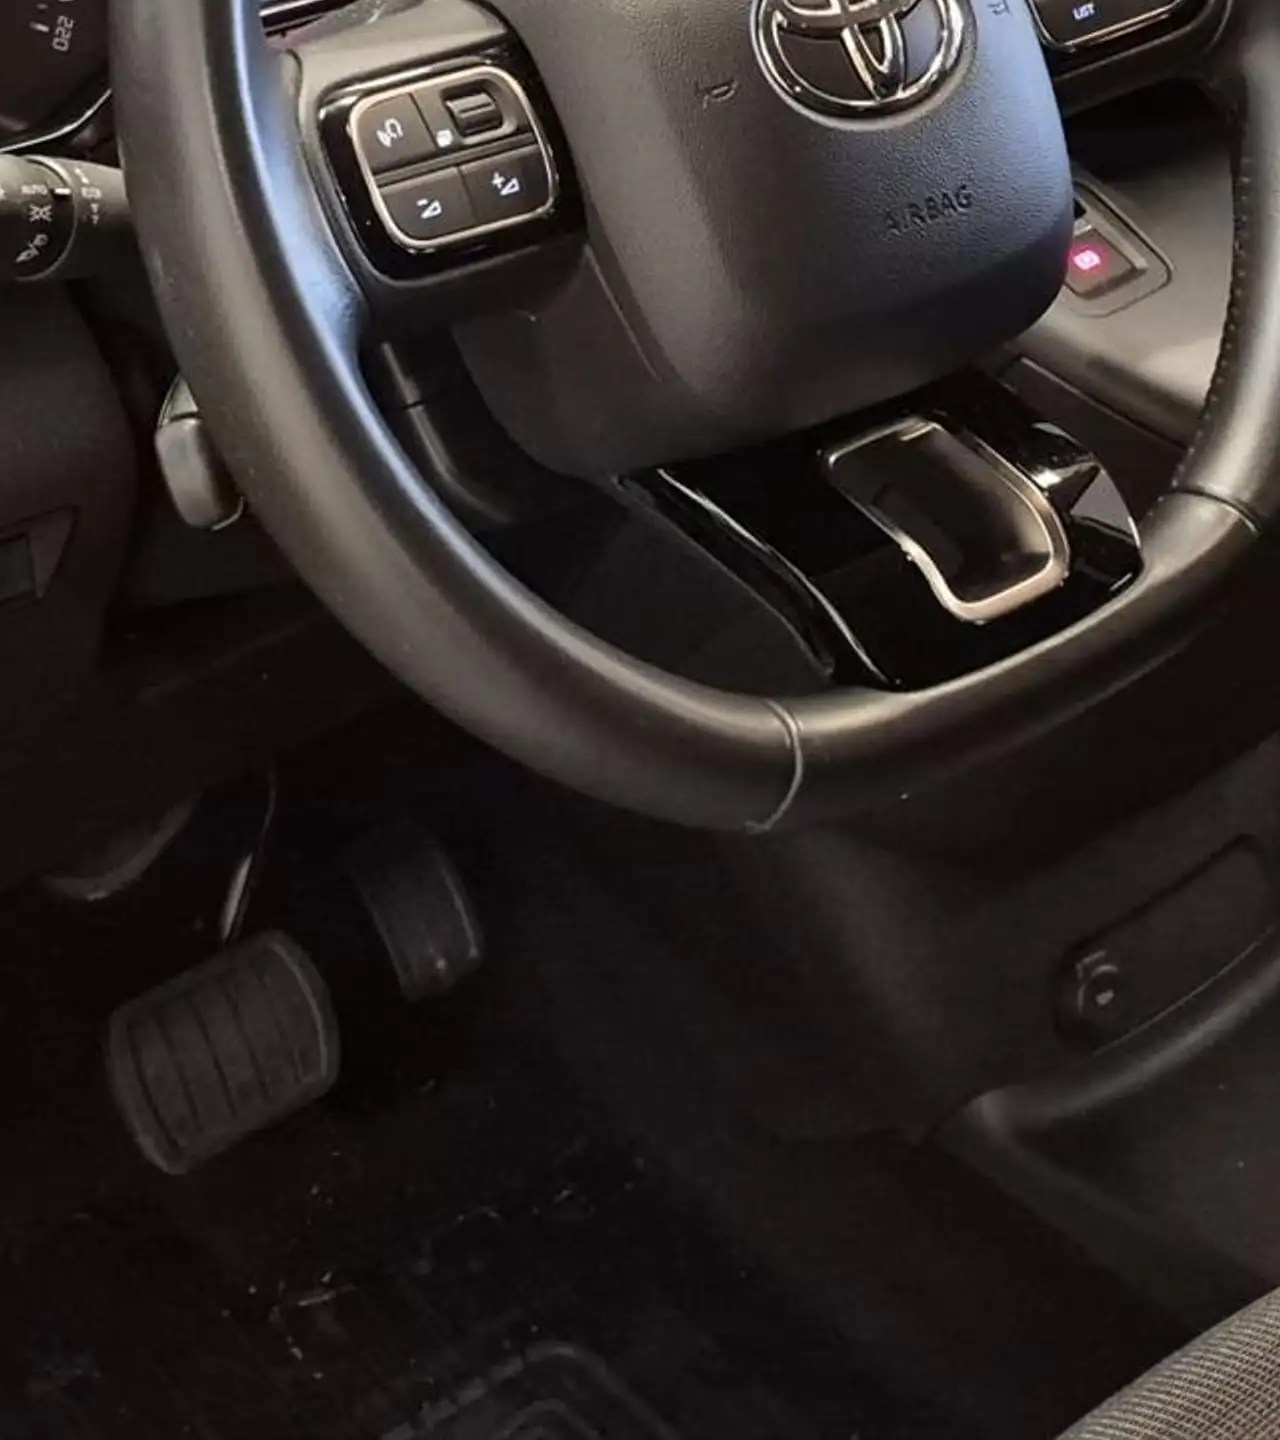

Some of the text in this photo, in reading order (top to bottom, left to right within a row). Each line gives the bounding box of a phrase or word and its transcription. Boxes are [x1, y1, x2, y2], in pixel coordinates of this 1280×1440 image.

[1071, 1, 1096, 21] LIST
[52, 15, 75, 52] 220
[883, 183, 974, 236] AIRBAG
